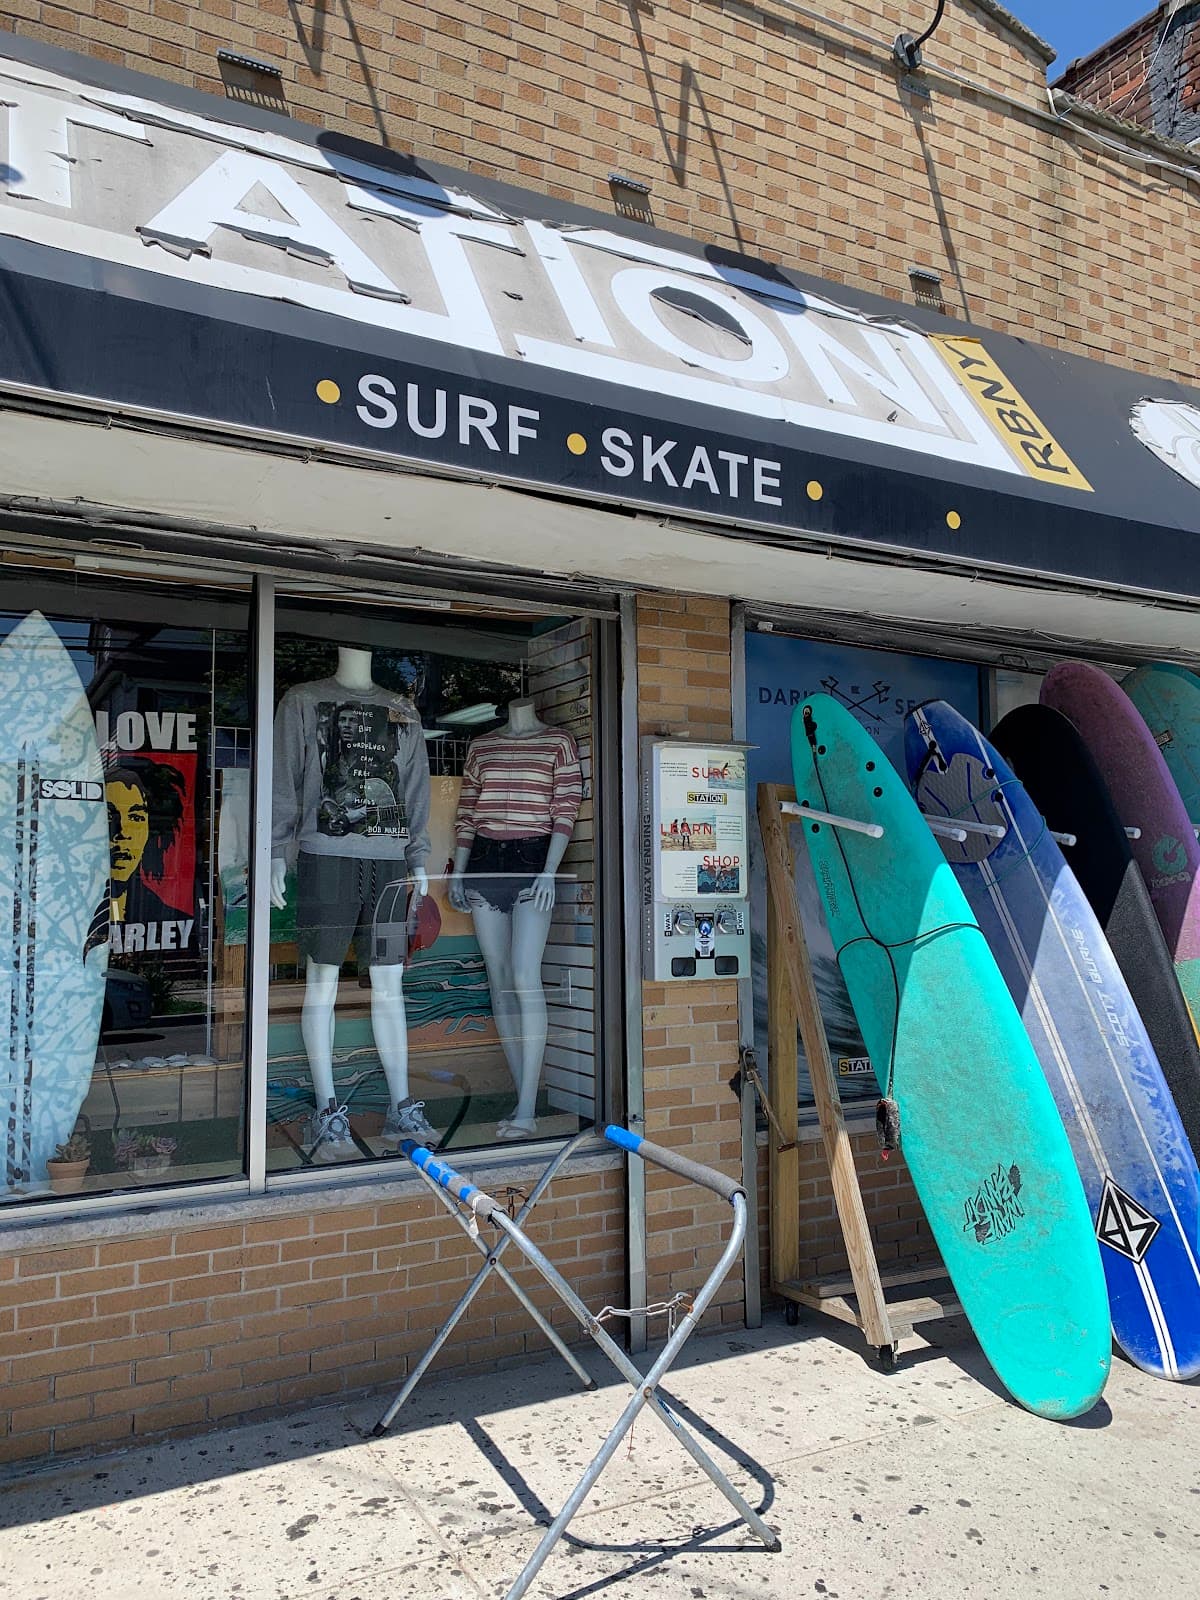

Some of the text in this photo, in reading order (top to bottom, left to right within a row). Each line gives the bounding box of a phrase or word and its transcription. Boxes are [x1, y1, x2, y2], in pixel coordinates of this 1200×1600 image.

[943, 340, 1071, 475] RBNY
[356, 374, 783, 507] SURF SKATE
[96, 710, 197, 751] LOVE
[691, 766, 729, 779] SURF
[41, 780, 102, 800] SOLID
[687, 792, 724, 803] STATION
[368, 825, 382, 833] BOB
[660, 823, 713, 836] LEARN
[643, 814, 652, 906] WAX VENDING
[703, 855, 740, 867] SHOP
